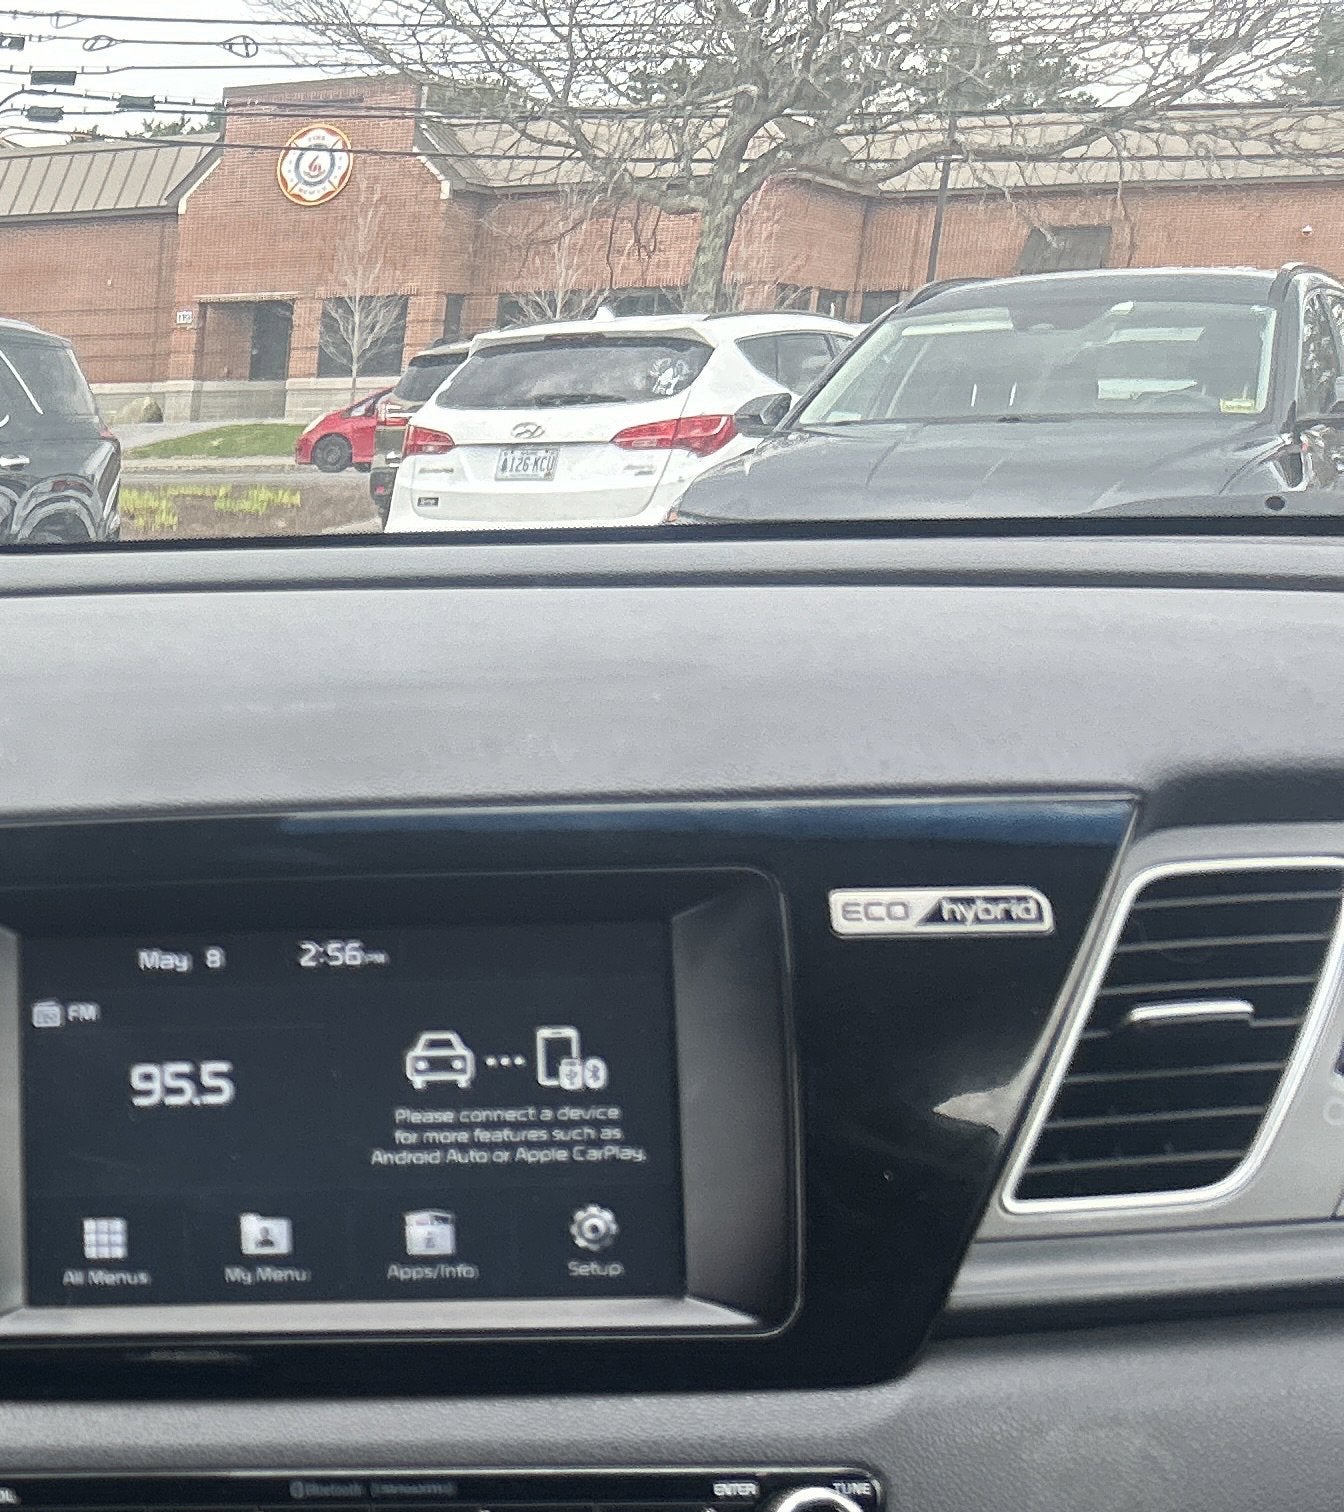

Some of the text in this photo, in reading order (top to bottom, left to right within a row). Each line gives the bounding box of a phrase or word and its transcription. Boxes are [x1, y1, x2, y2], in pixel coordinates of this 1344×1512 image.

[841, 896, 1039, 926] ECO hybrid
[137, 949, 191, 973] May
[204, 947, 226, 969] 8
[67, 1003, 99, 1023] FM
[130, 1061, 236, 1107] 95.5
[394, 1105, 621, 1124] Please connect a device
[393, 1125, 622, 1144] for more features such as
[371, 1145, 646, 1166] Android Auto or Apple CarPlay.
[62, 1268, 150, 1287] All Menus
[224, 1266, 309, 1284] My Menu
[387, 1262, 478, 1283] Apps/Info
[568, 1259, 623, 1280] Setup
[714, 1481, 759, 1497] ENTER
[833, 1481, 873, 1497] TUNE
